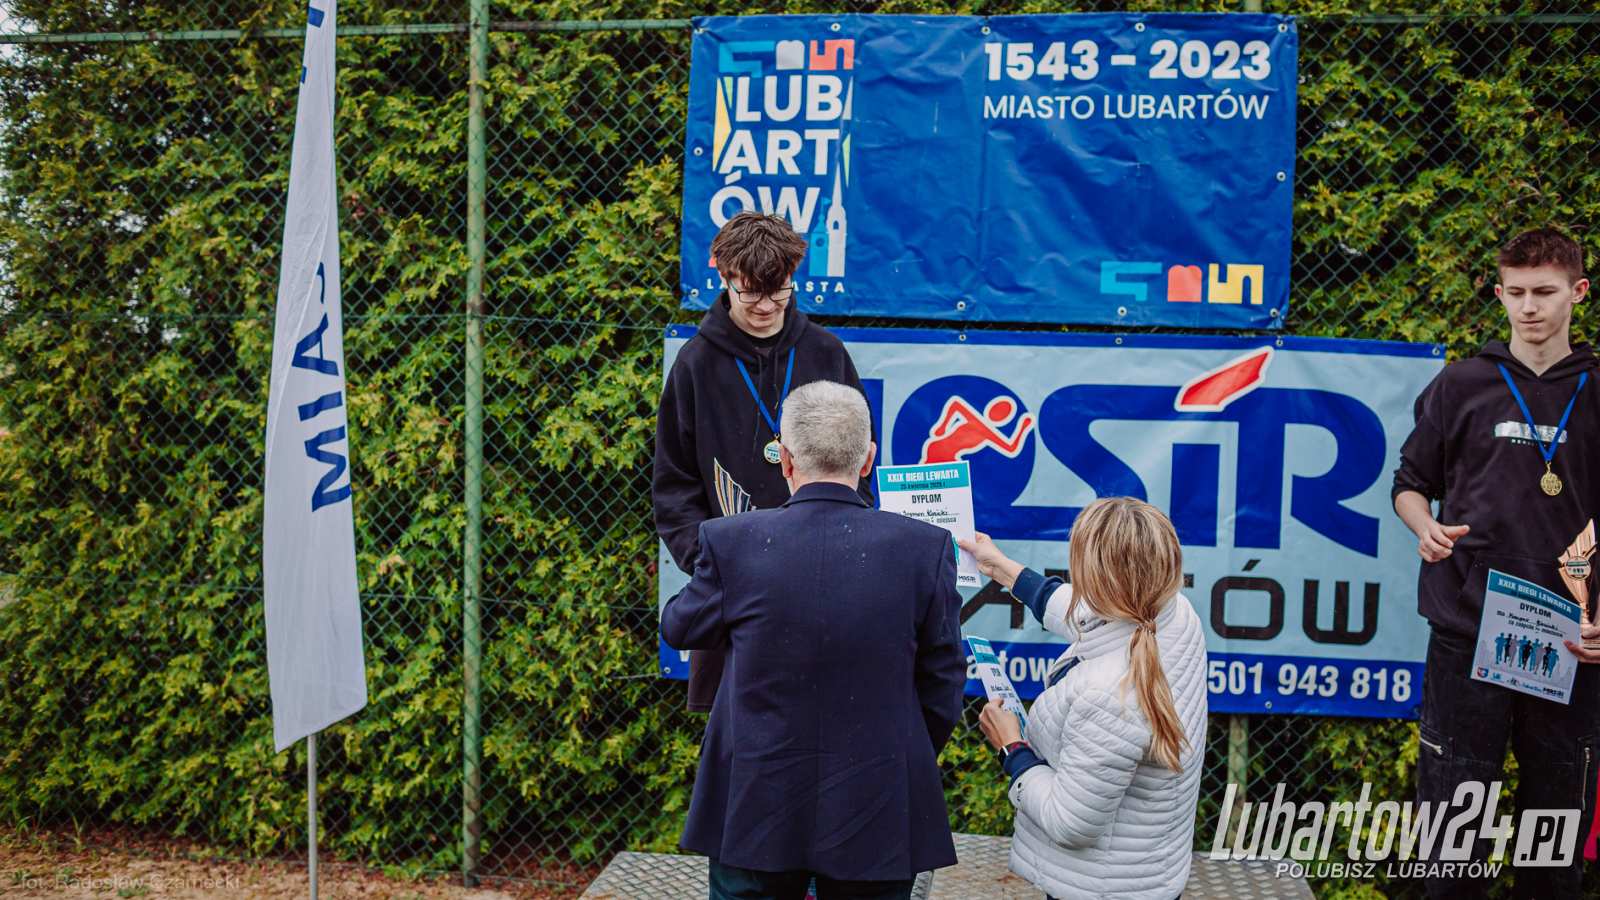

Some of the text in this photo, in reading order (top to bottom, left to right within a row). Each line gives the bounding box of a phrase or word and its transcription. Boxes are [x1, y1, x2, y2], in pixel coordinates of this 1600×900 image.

[984, 39, 1099, 81] 1543
[1149, 39, 1271, 80] 2023
[735, 75, 843, 122] LUB
[983, 88, 1270, 120] MIASTO LUBARTÓW
[718, 128, 839, 175] ART
[709, 170, 820, 234] ÓW
[911, 494, 942, 504] DYPLOM
[1519, 602, 1552, 618] DYPLOM
[1207, 659, 1412, 703] 501 943 818
